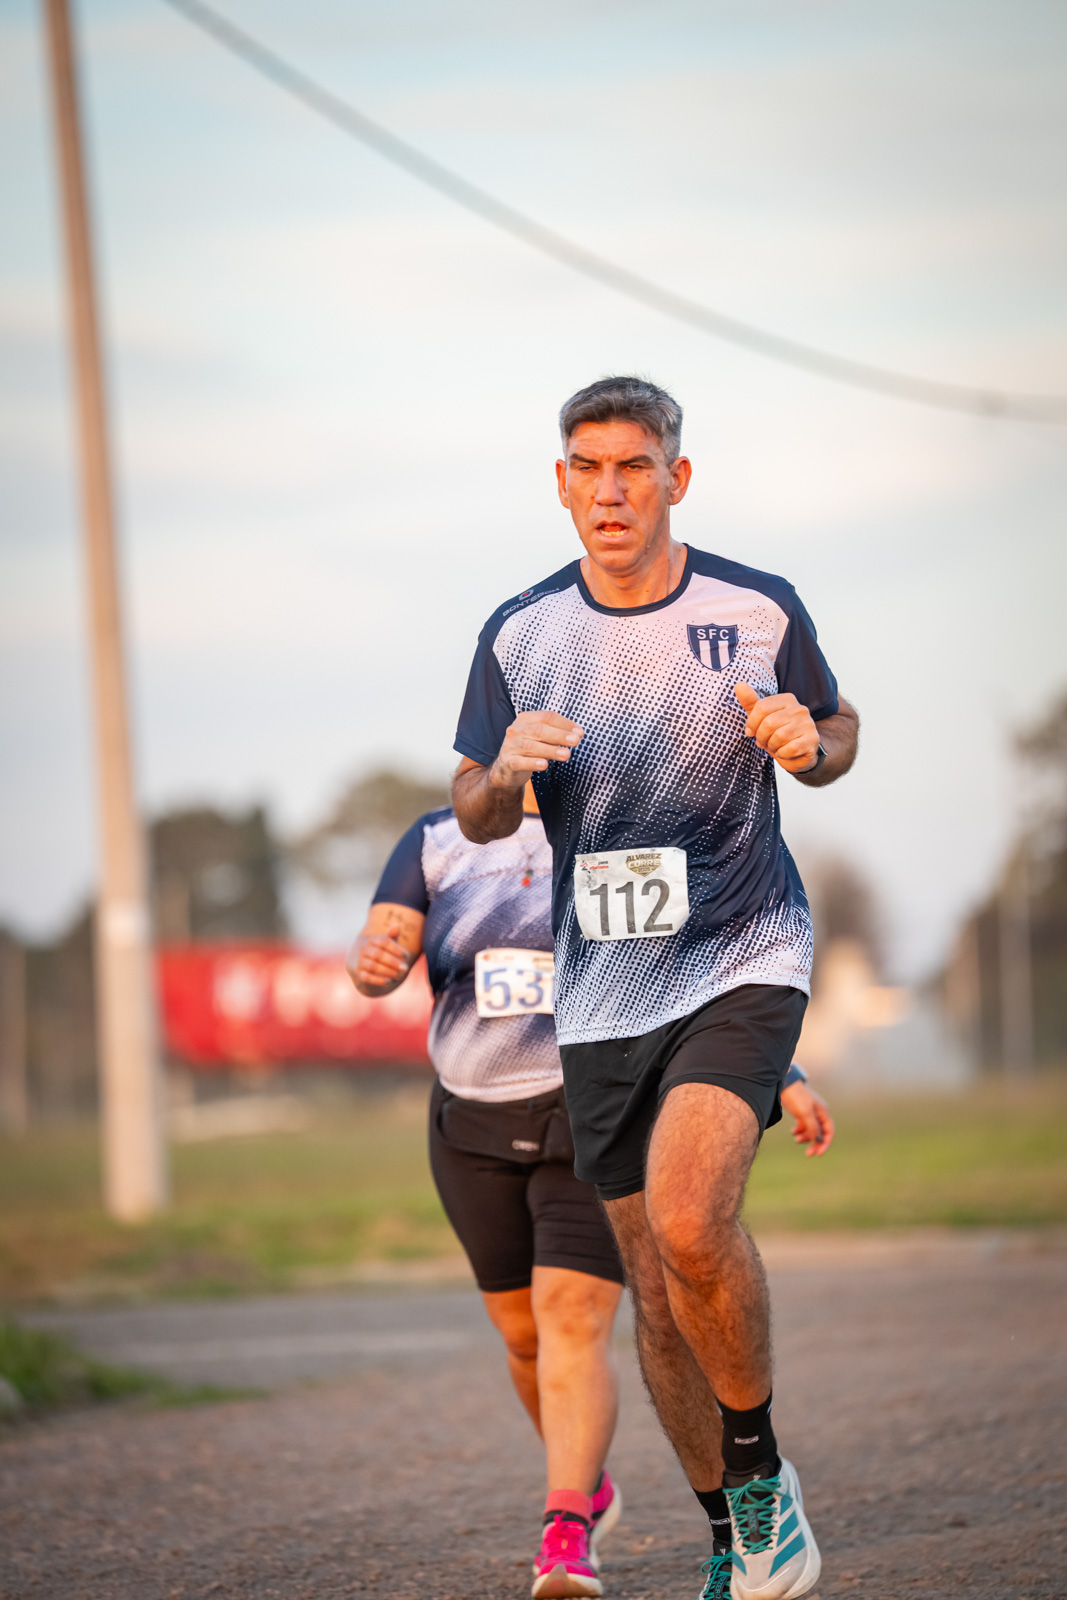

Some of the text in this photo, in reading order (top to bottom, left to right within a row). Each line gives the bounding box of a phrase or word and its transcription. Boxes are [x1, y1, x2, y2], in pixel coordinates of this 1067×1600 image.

[696, 628, 730, 640] SFC
[626, 853, 662, 863] ALVAREZ
[628, 859, 661, 869] CORRE
[589, 878, 673, 936] 112
[483, 968, 555, 1011] 53
